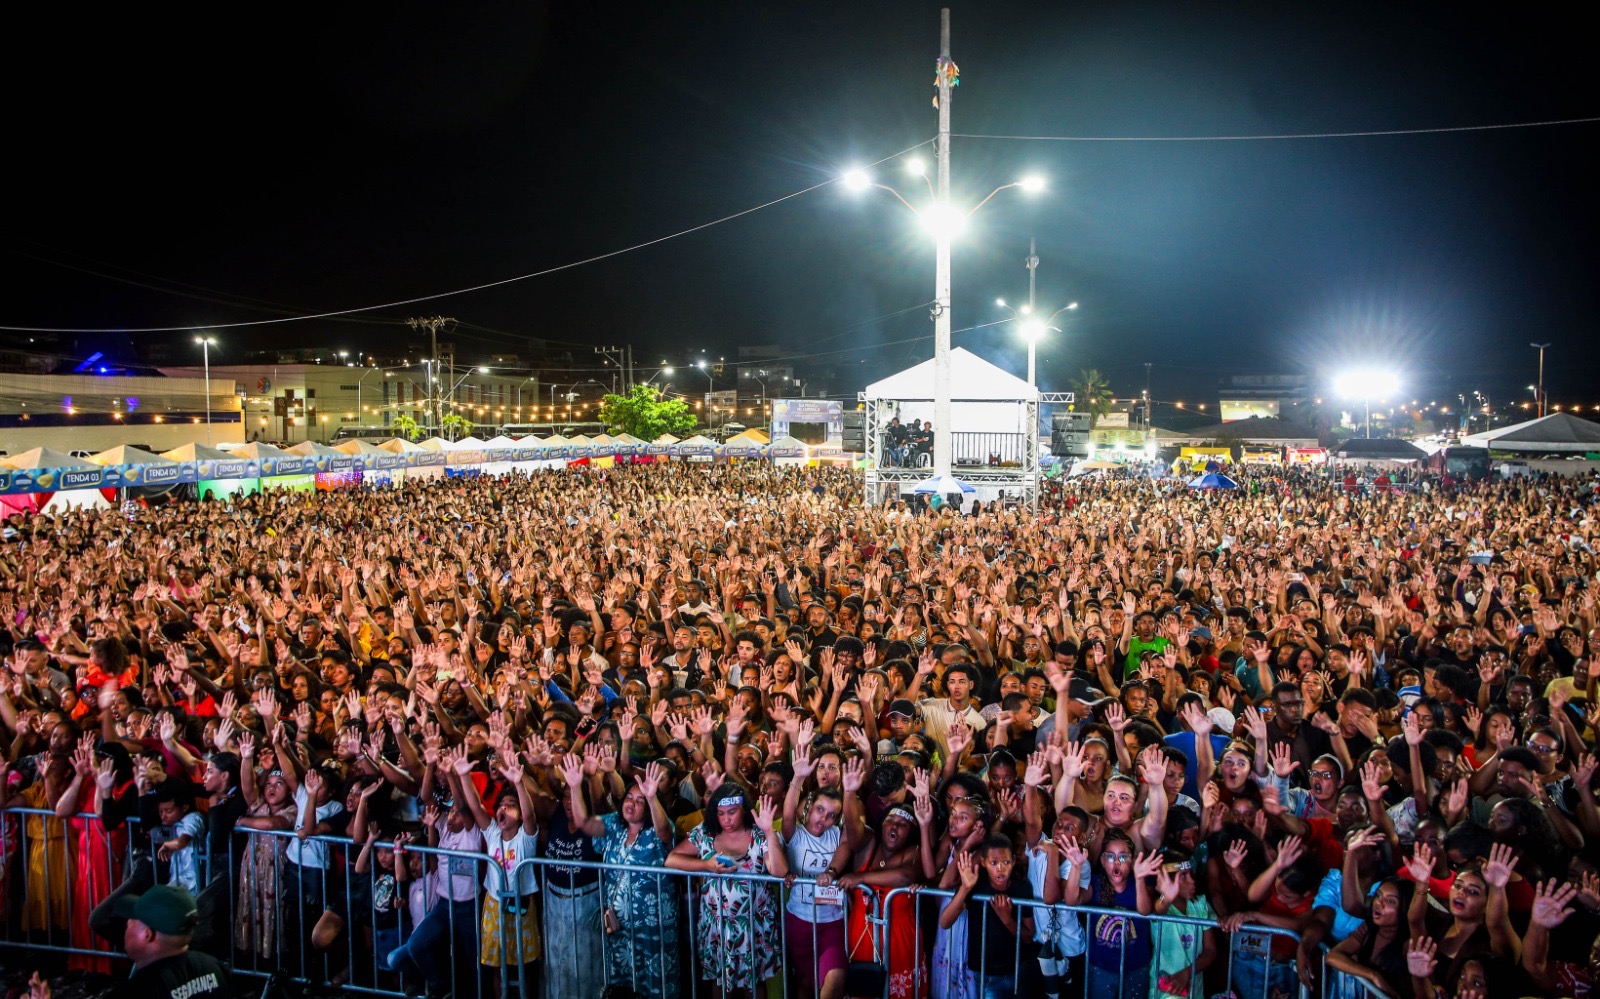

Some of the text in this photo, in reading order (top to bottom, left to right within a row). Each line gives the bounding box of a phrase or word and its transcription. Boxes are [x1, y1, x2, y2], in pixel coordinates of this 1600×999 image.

[219, 464, 236, 473] TENDA
[280, 462, 295, 470] TENDA
[149, 468, 169, 477] TENDA
[169, 468, 177, 476] 04
[67, 473, 90, 483] TENDA
[90, 473, 100, 482] 03
[718, 797, 740, 806] JESUS
[891, 808, 914, 822] JESUS
[171, 972, 219, 999] SEGURANÇA
